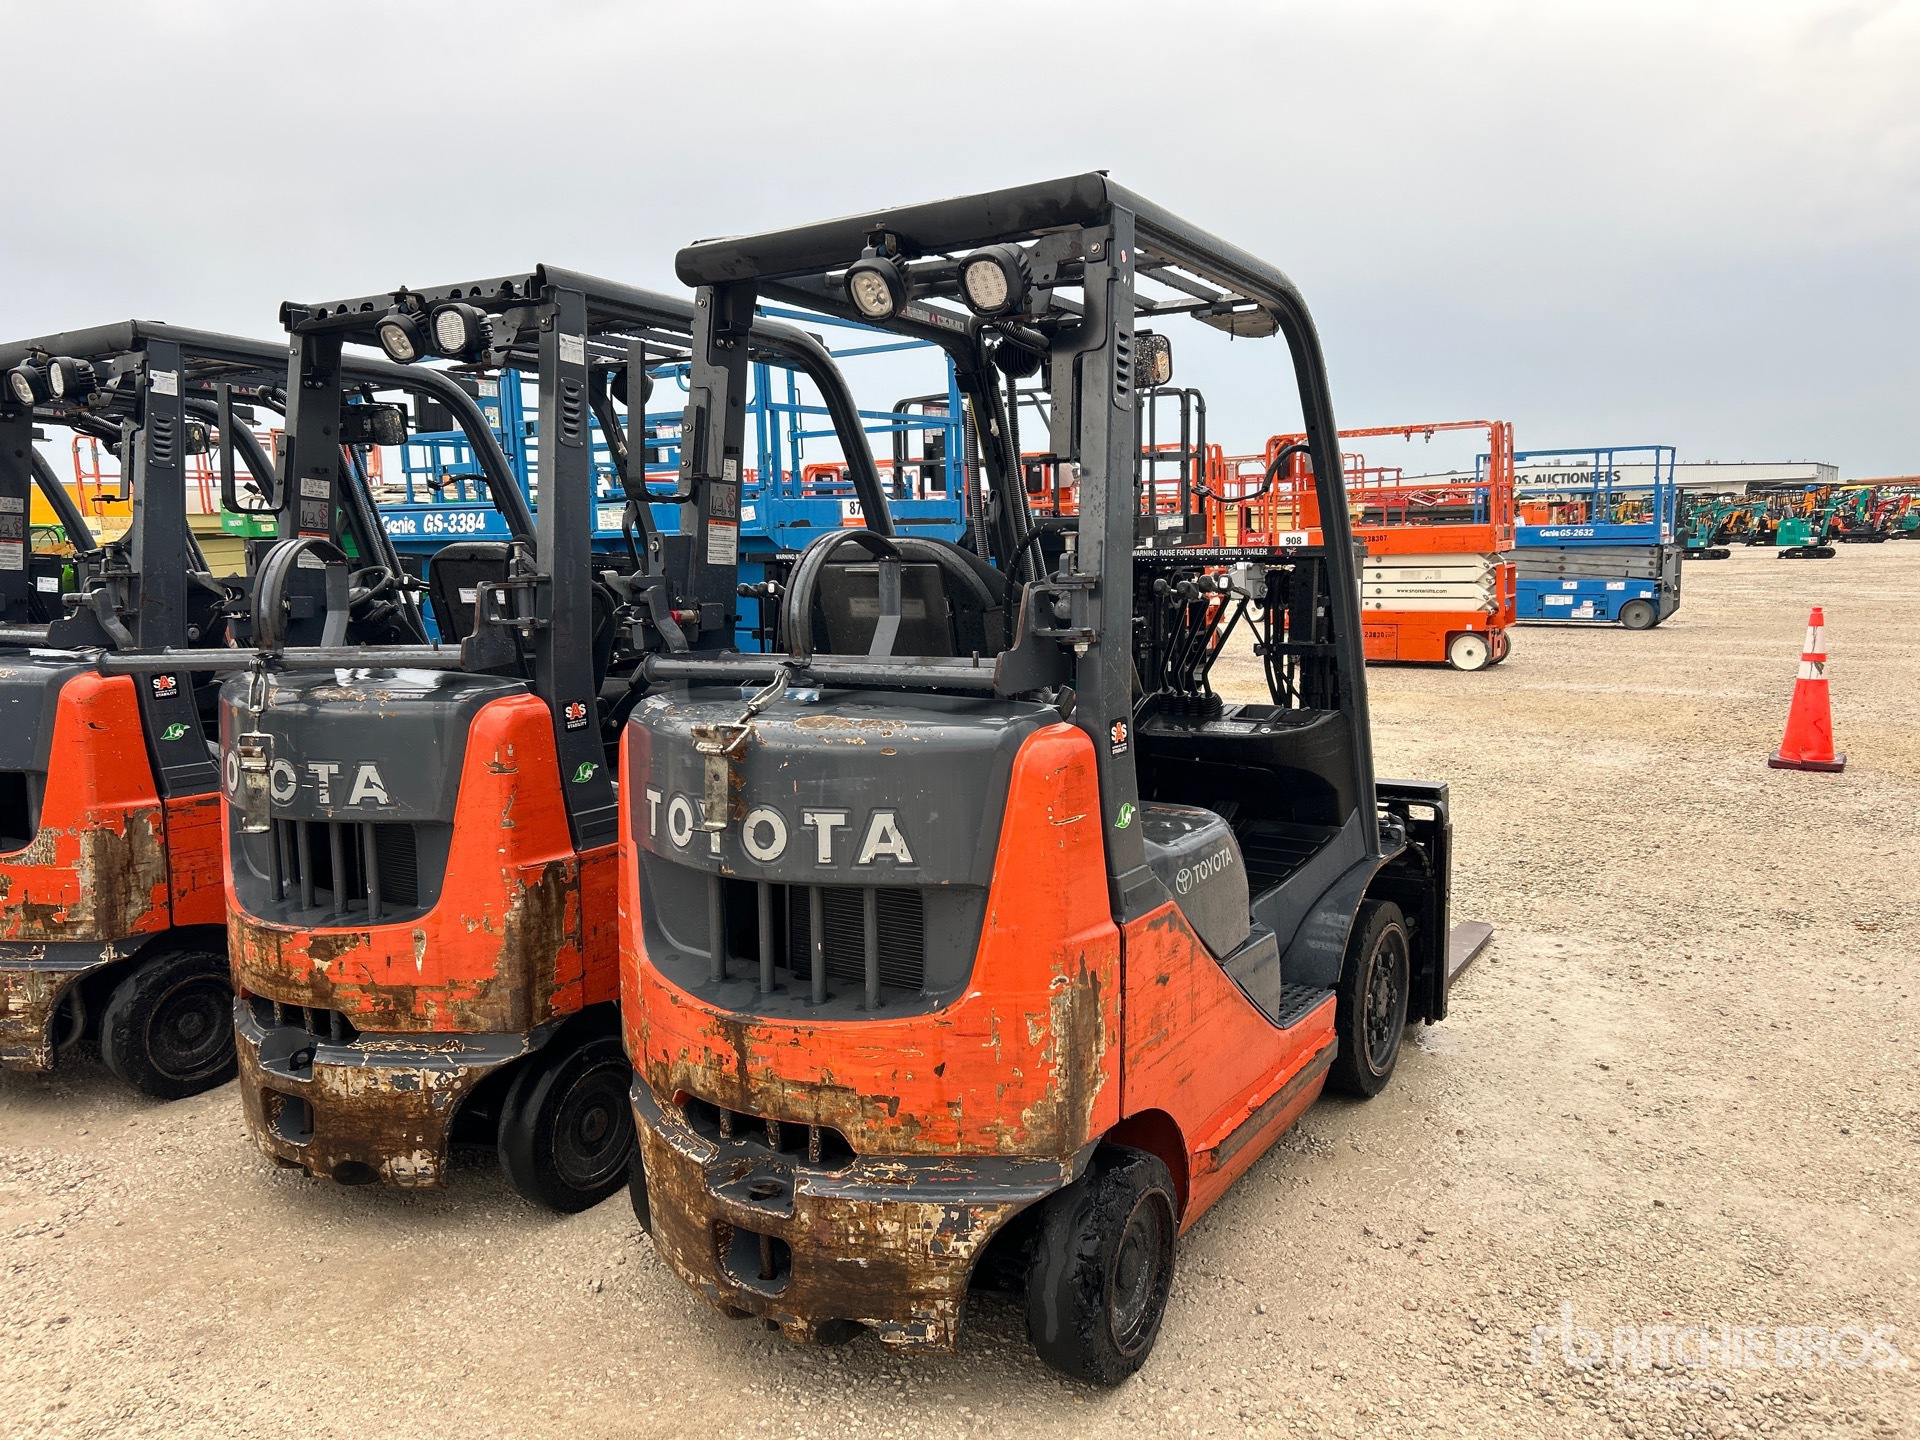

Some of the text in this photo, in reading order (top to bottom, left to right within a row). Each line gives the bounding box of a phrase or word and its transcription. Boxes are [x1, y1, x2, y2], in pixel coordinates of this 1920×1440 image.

[849, 501, 862, 515] 87
[382, 512, 486, 534] Genie GS-3384
[1363, 535, 1388, 543] 238307
[1539, 528, 1594, 537] Genie GS-2632
[1285, 536, 1303, 545] 908
[1132, 547, 1268, 557] WARNING: RAISE FORKS BEFORE EXITING TRAILER
[153, 675, 177, 690] SAS
[565, 702, 587, 720] SAS
[1111, 721, 1128, 743] SAS
[221, 749, 388, 805] OOTA
[1192, 847, 1234, 884] TOYOTA
